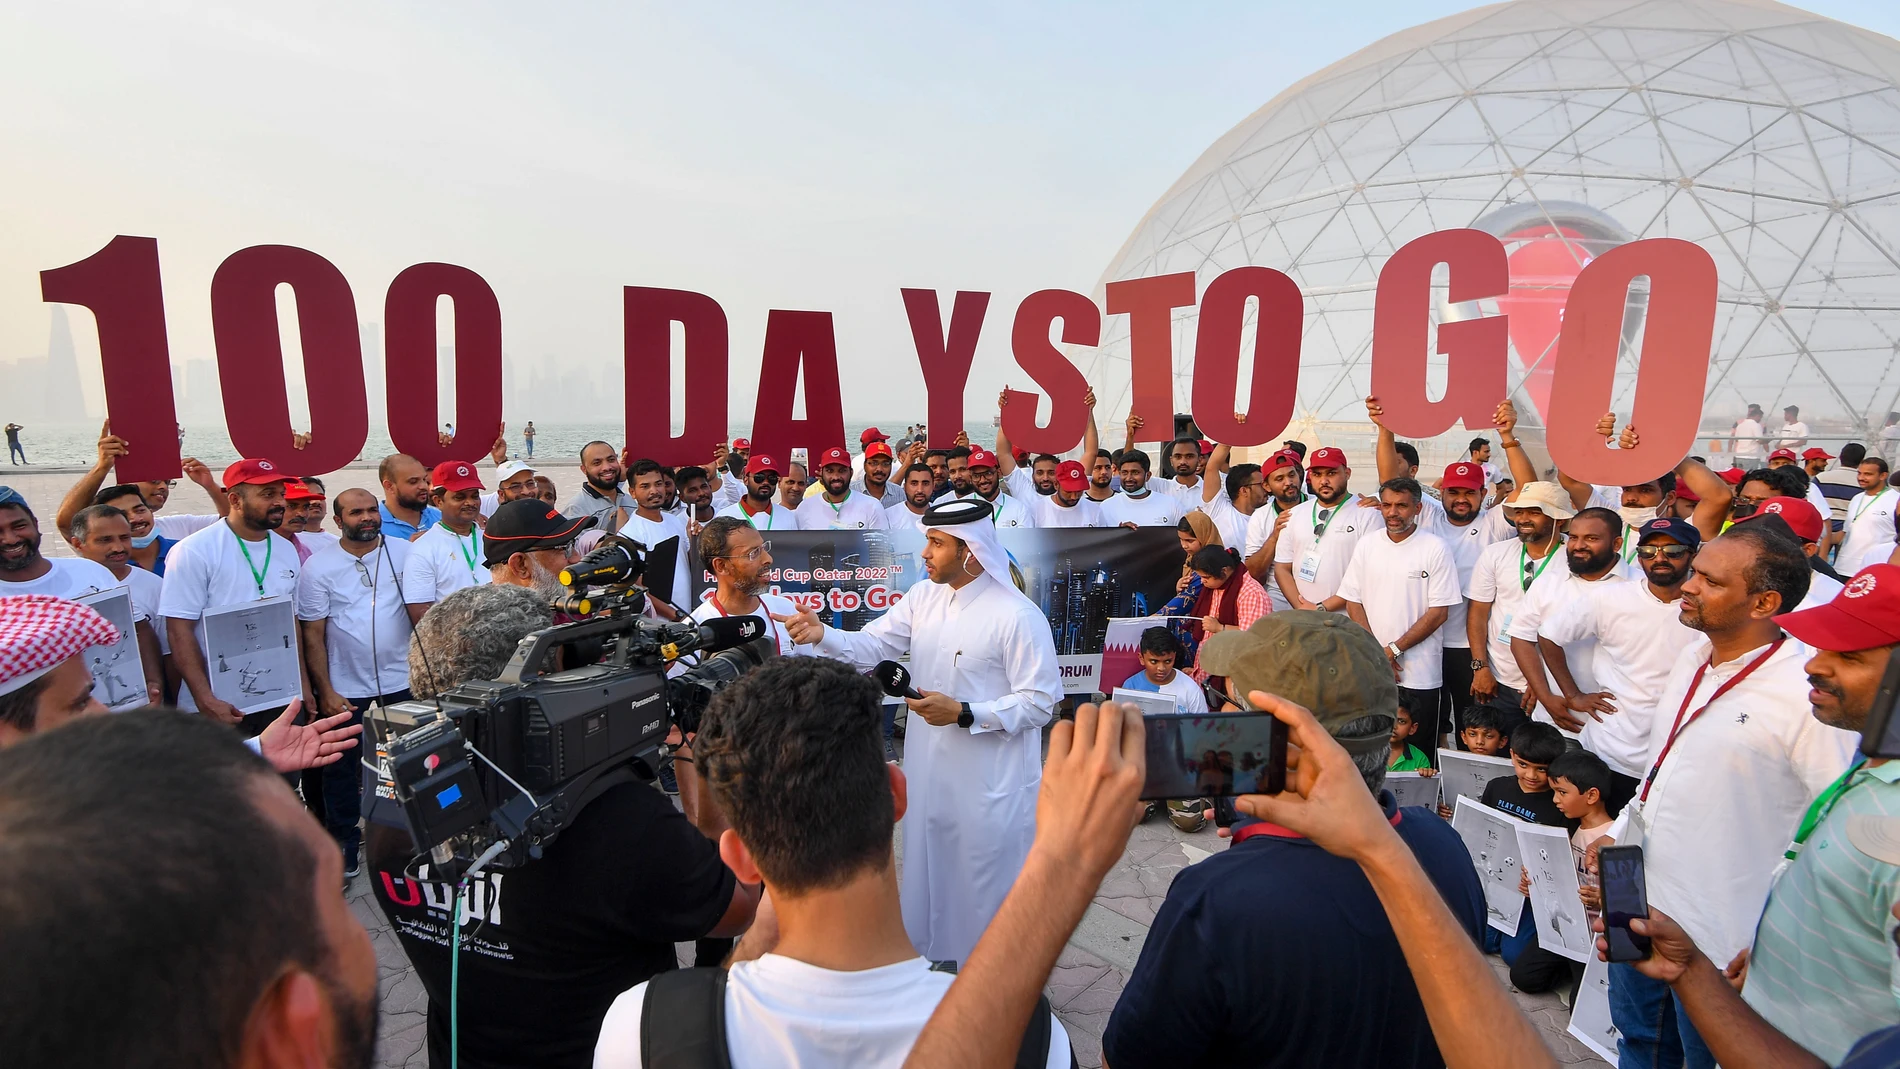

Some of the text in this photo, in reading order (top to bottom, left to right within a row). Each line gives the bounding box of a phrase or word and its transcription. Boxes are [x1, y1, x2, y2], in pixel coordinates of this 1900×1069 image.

[40, 228, 1718, 486] 100 DAYS TO GO
[783, 570, 810, 583] Cup
[814, 569, 853, 581] Qatar
[830, 591, 858, 609] to
[1058, 664, 1093, 677] ORUM
[631, 692, 661, 709] Panasonic
[1497, 799, 1536, 820] PLAY GAME
